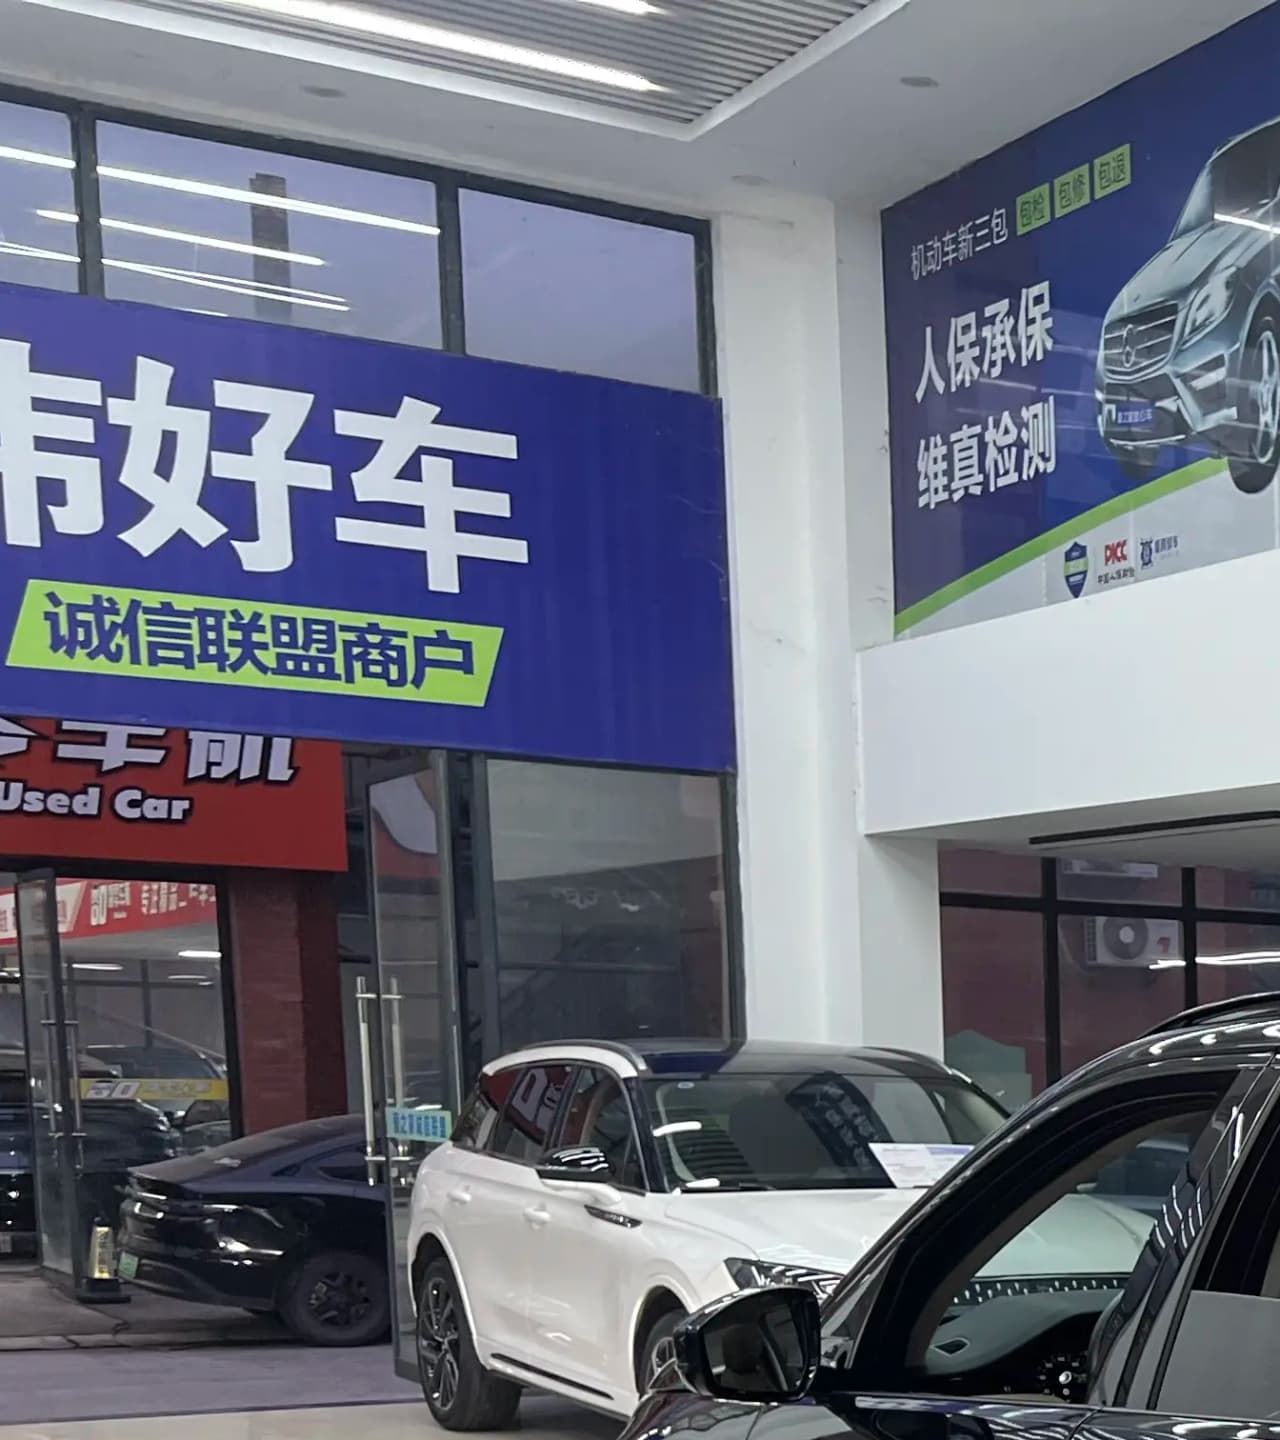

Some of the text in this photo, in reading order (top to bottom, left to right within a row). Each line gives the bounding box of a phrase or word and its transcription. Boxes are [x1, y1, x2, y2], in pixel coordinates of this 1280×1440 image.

[910, 207, 1009, 281] 机动车新三包
[915, 280, 1054, 404] 人保承保
[916, 394, 1057, 510] 维真检测
[43, 591, 476, 689] 诚信联盟商户
[114, 788, 191, 821] Car
